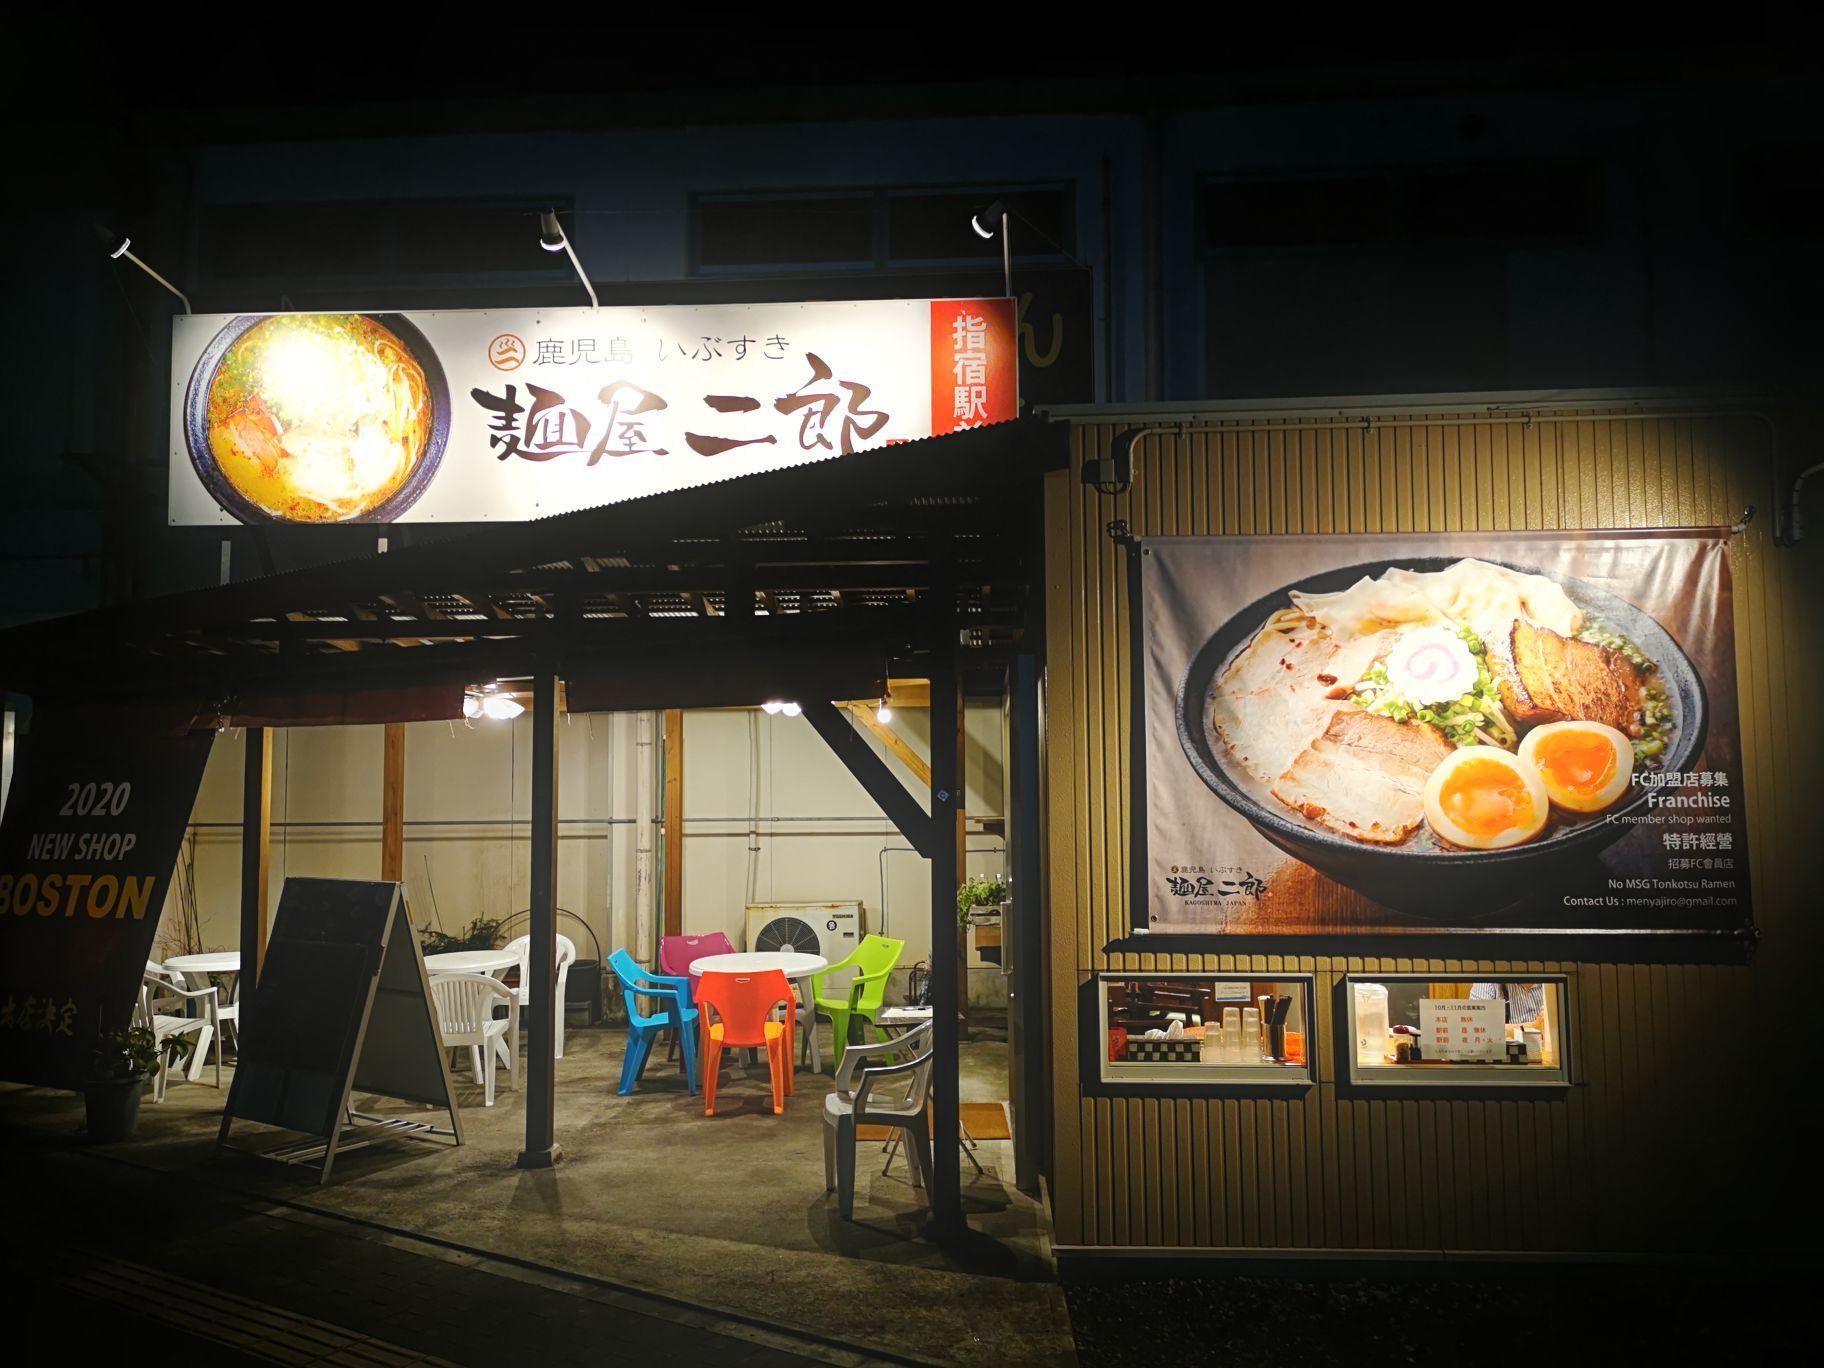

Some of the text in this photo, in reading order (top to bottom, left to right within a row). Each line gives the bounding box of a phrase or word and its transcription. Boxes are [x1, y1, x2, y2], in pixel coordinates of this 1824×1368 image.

[532, 334, 790, 366] 鹿児島 いぶすき
[1631, 772, 1728, 787] FC加盟店募集
[58, 781, 131, 816] 2020
[1647, 792, 1730, 808] Franchise
[1606, 814, 1732, 826] FC member shop wanted
[27, 832, 137, 861] NEW SHOP
[1663, 833, 1733, 850] 特許經營
[1608, 879, 1736, 889] No MSG Tonkotsu Ramen
[1563, 895, 1604, 906] Contact
[1626, 896, 1737, 909] menyajiro@gmail.com
